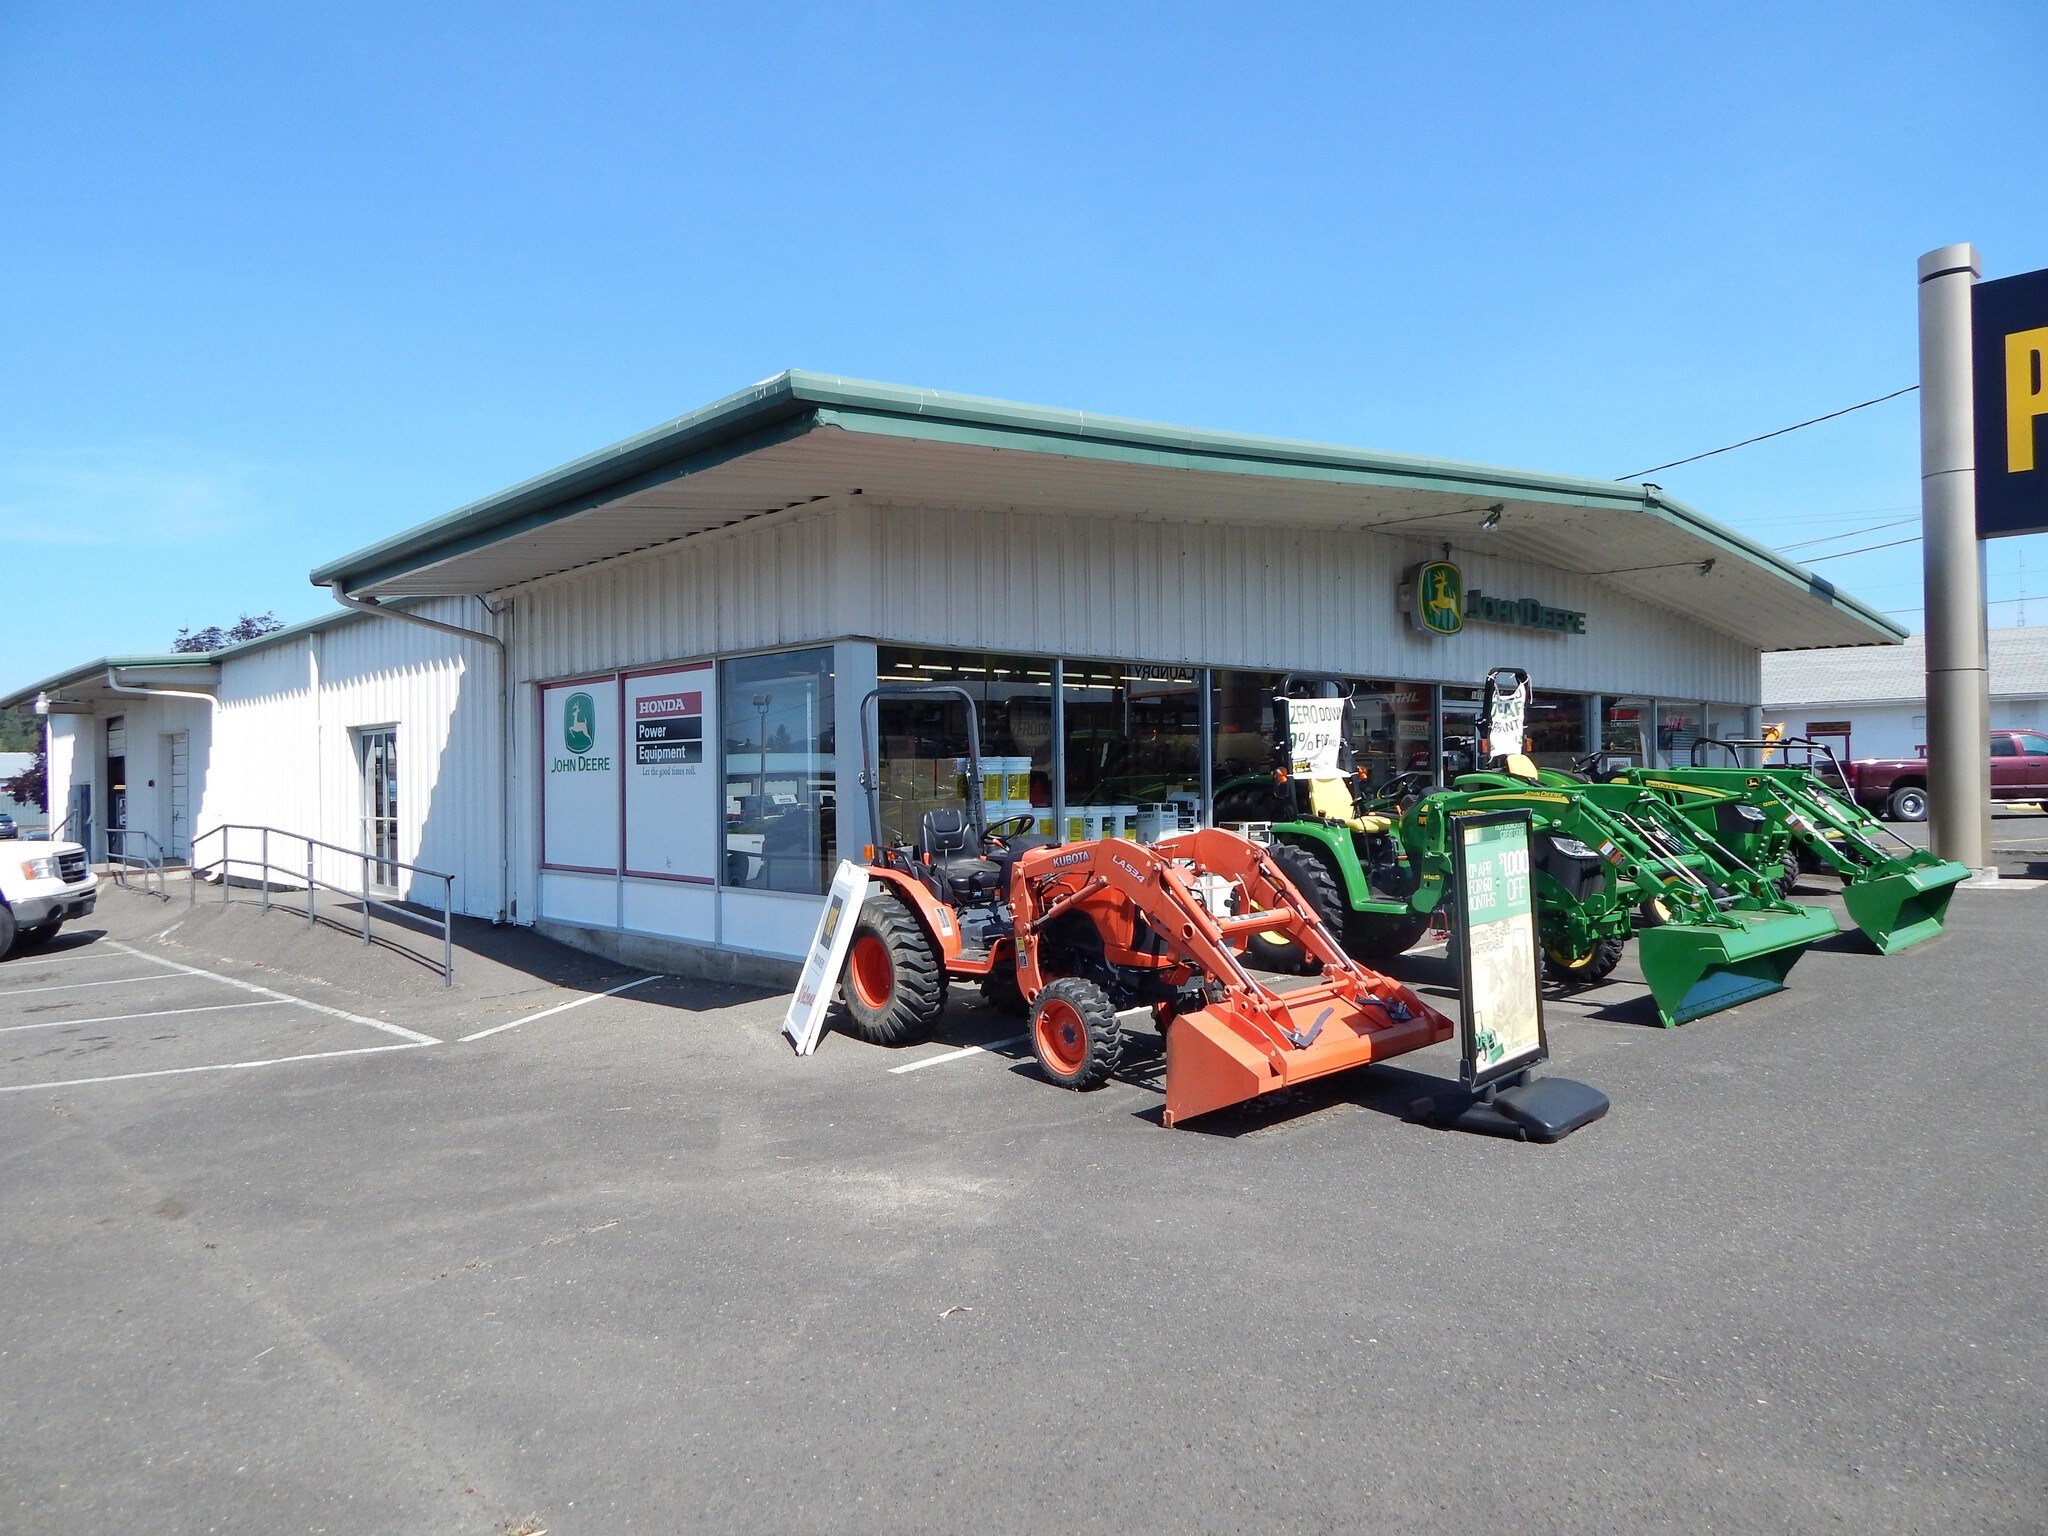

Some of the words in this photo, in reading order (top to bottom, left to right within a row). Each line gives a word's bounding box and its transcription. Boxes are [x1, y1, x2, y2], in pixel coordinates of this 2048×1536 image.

[1464, 589, 1520, 625] JOHN
[1518, 598, 1587, 635] DEERE
[639, 698, 685, 714] HONDA
[1289, 704, 1319, 725] ZERO
[639, 724, 667, 739] Power
[639, 745, 686, 762] Equipment
[551, 757, 576, 773] JOHN
[578, 755, 611, 772] DEERE
[642, 767, 650, 776] Let
[651, 766, 659, 775] the
[659, 766, 671, 778] good
[671, 765, 685, 775] times
[685, 765, 696, 775] roll.
[1053, 851, 1090, 868] KUBOTA
[1111, 854, 1146, 883] LA534
[1507, 876, 1526, 902] OFF
